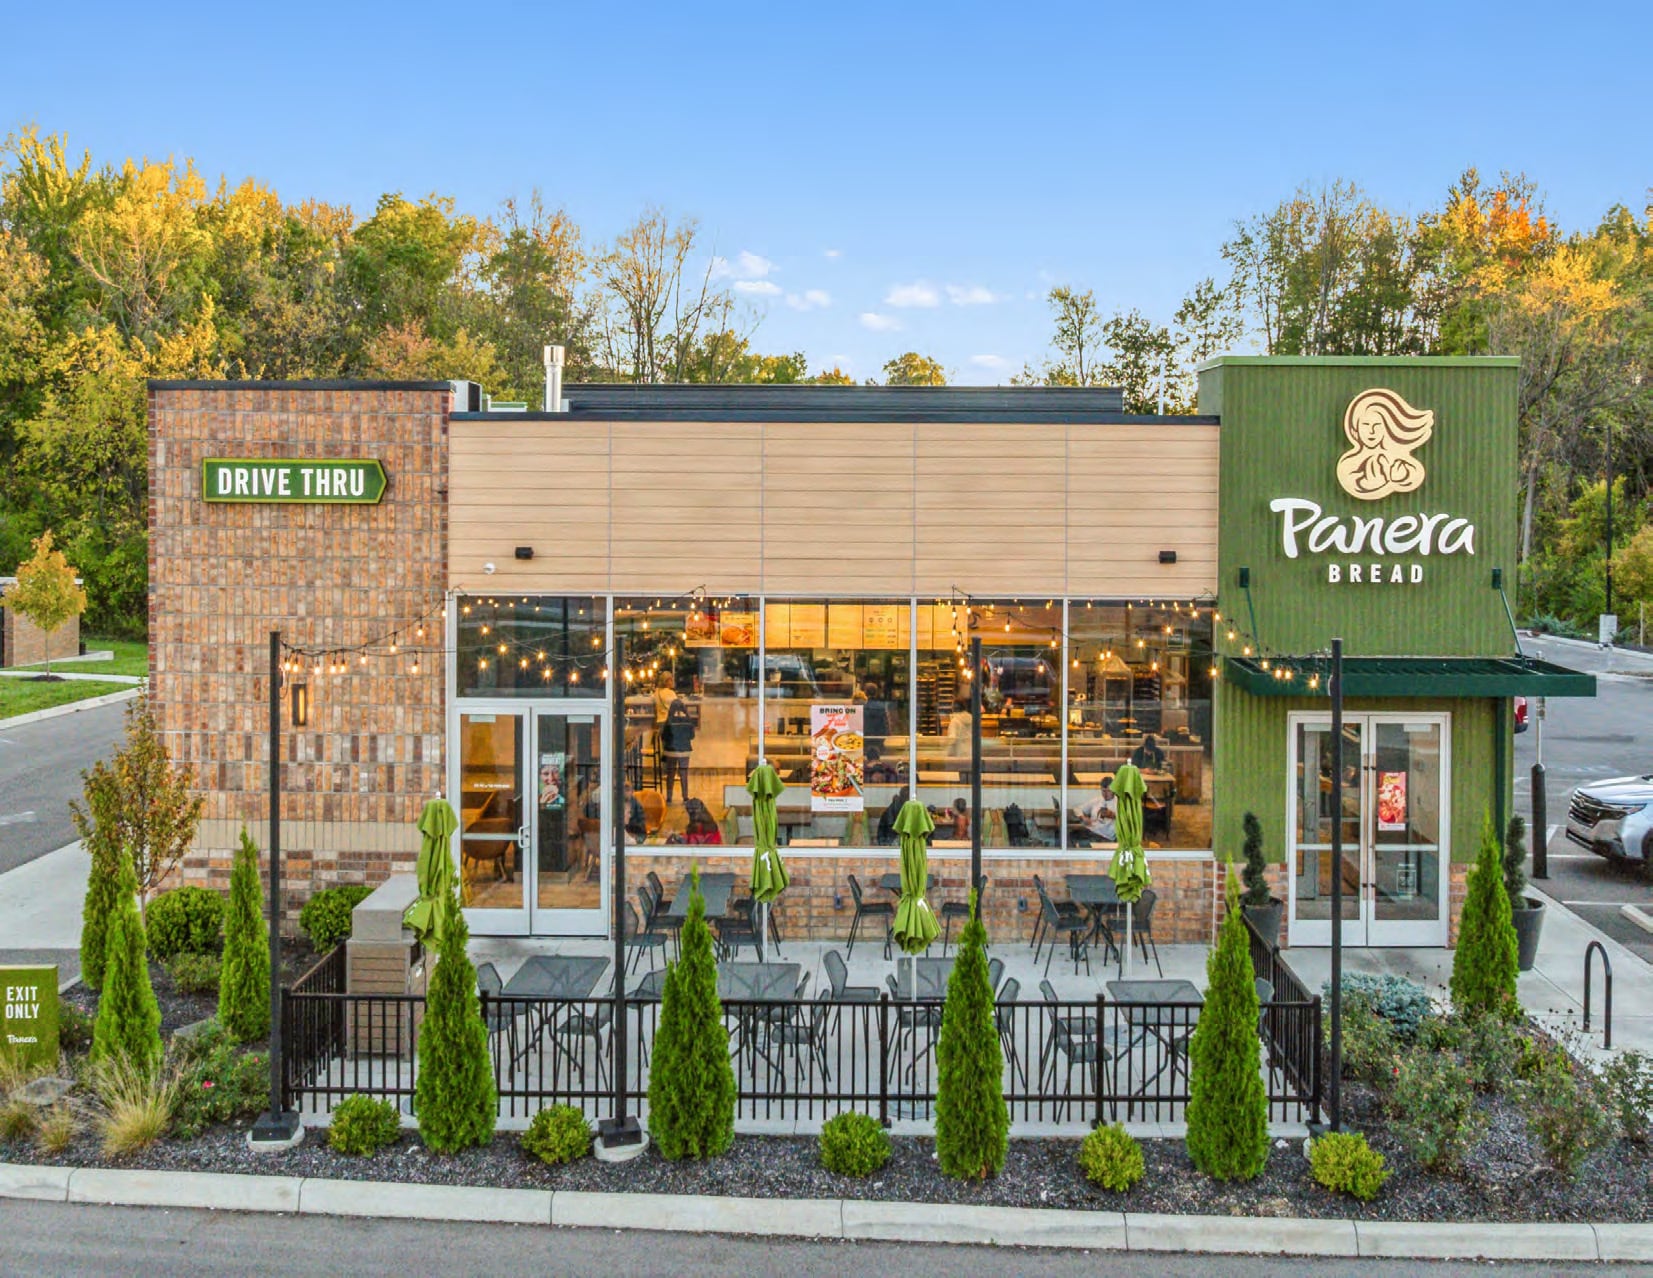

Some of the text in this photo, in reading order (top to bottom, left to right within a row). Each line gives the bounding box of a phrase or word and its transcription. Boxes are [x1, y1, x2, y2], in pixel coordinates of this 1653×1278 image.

[218, 468, 364, 497] DRIVE THRU
[1269, 497, 1475, 559] Panera
[1328, 564, 1423, 583] BREAD
[6, 986, 38, 1001] EXIT
[5, 1003, 40, 1019] ONLY
